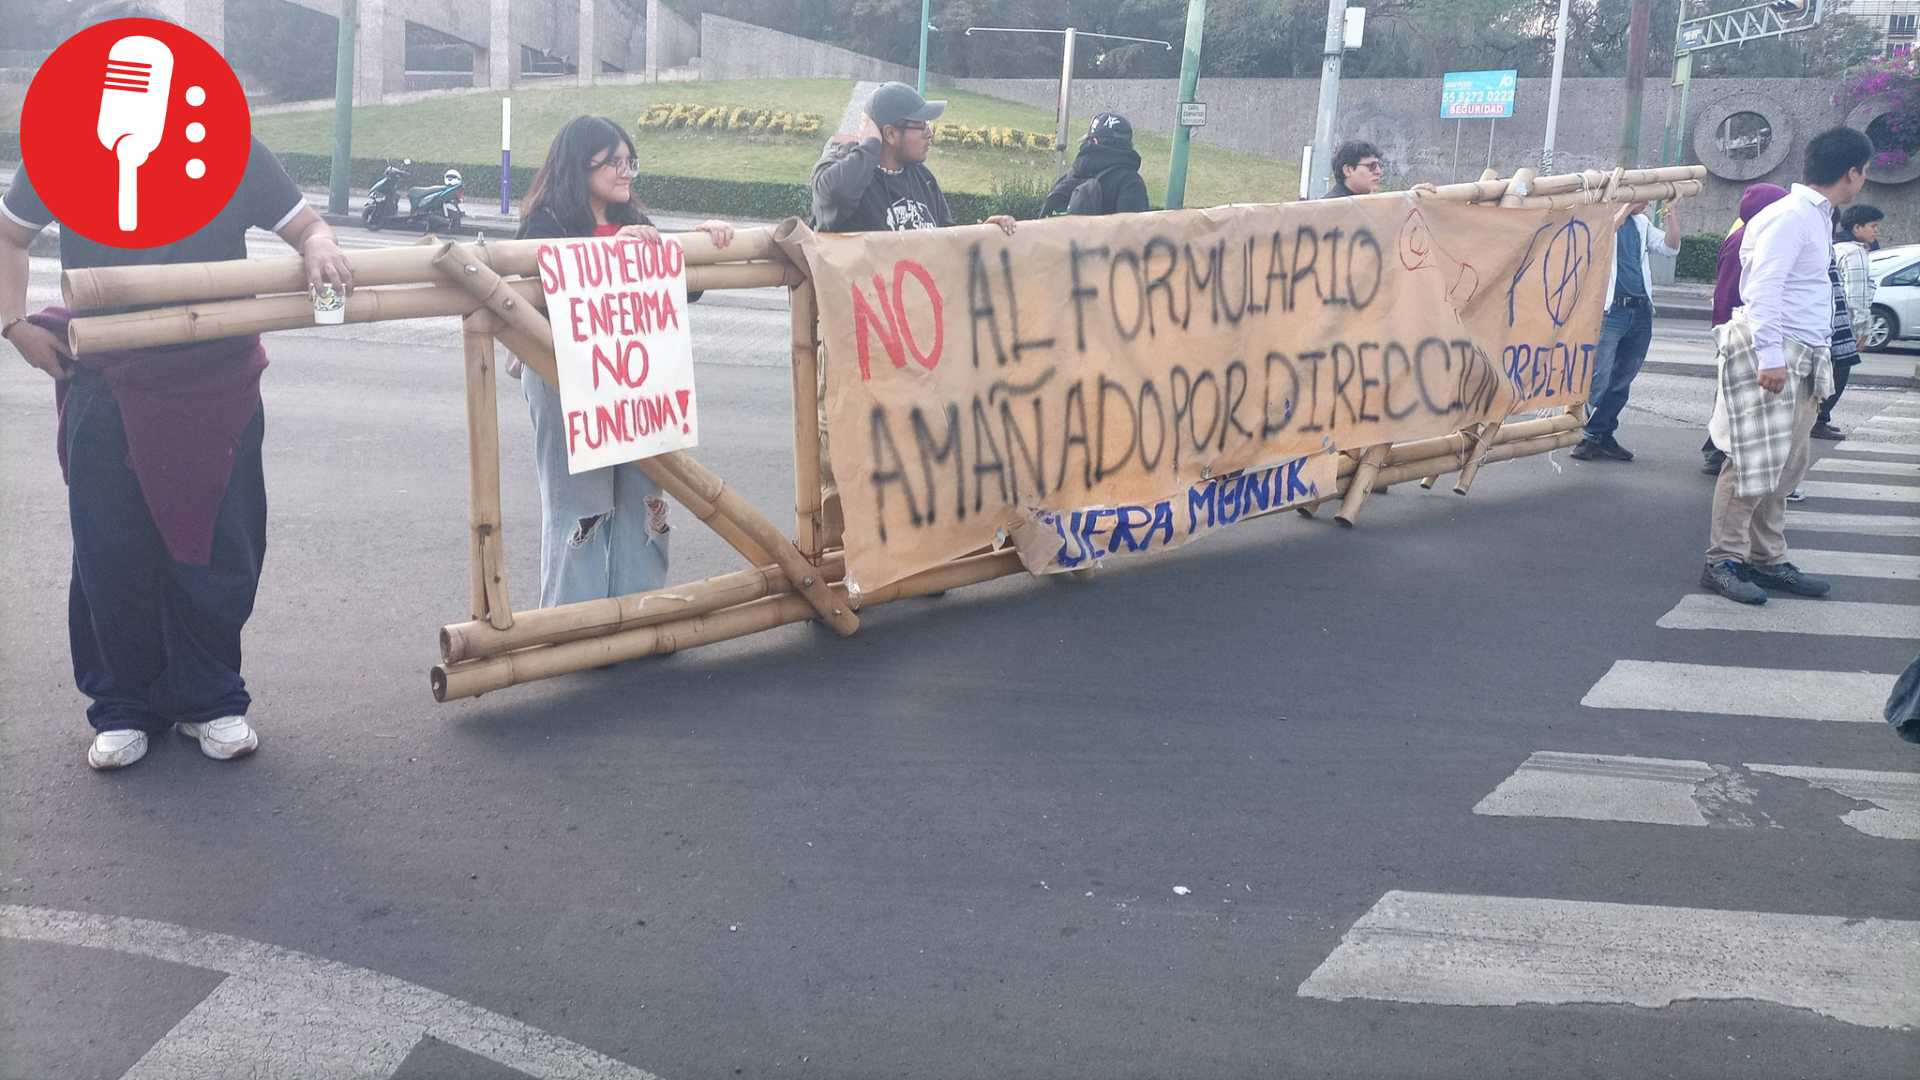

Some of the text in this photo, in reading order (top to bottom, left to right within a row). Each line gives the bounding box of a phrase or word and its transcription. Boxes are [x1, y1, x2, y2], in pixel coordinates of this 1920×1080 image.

[1449, 104, 1504, 115] SEGURIDAD
[1458, 91, 1483, 103] 5272
[1487, 90, 1515, 102] 0222
[537, 244, 566, 294] SI
[569, 291, 679, 343] ENFERMA
[851, 224, 1383, 382] NO AL FORMULARIO
[591, 338, 649, 391] NO
[568, 389, 691, 456] FUNCIONA!
[869, 367, 1166, 544] AMAÑADO
[1170, 361, 1253, 472] POR
[1043, 501, 1174, 568] UERA
